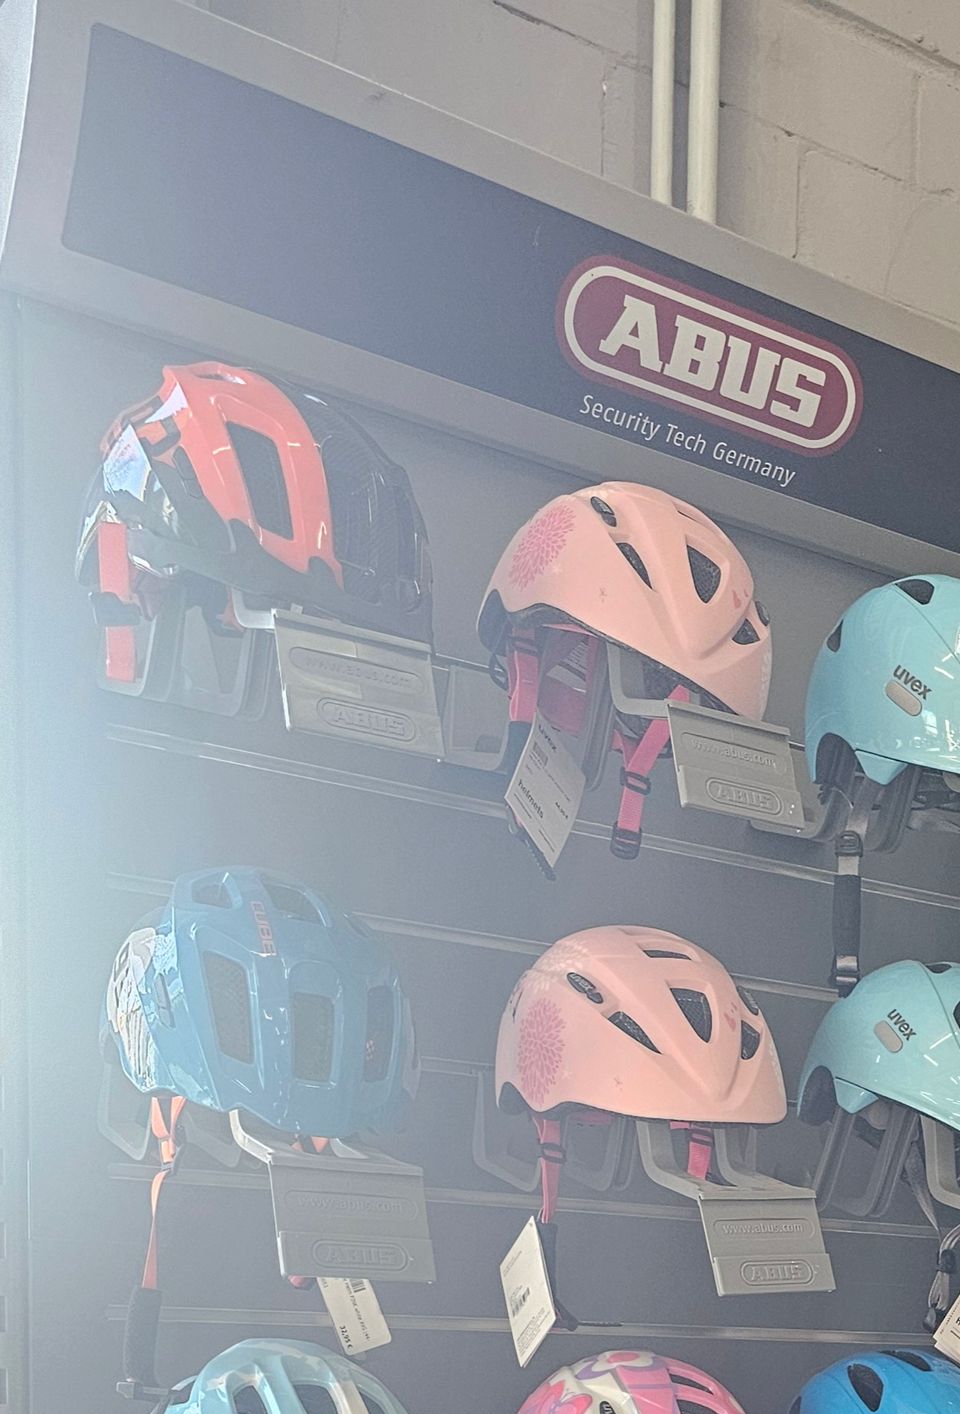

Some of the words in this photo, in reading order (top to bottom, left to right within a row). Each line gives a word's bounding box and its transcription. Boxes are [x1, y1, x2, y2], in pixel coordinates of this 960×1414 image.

[599, 294, 827, 428] ABUS
[580, 395, 660, 441] Security
[665, 422, 707, 455] Tech
[712, 442, 796, 487] Germany
[894, 663, 932, 700] uvex
[518, 779, 544, 819] helmets
[887, 1008, 917, 1041] uvex
[722, 1222, 803, 1235] www.abus.com
[751, 1265, 802, 1282] ABUS
